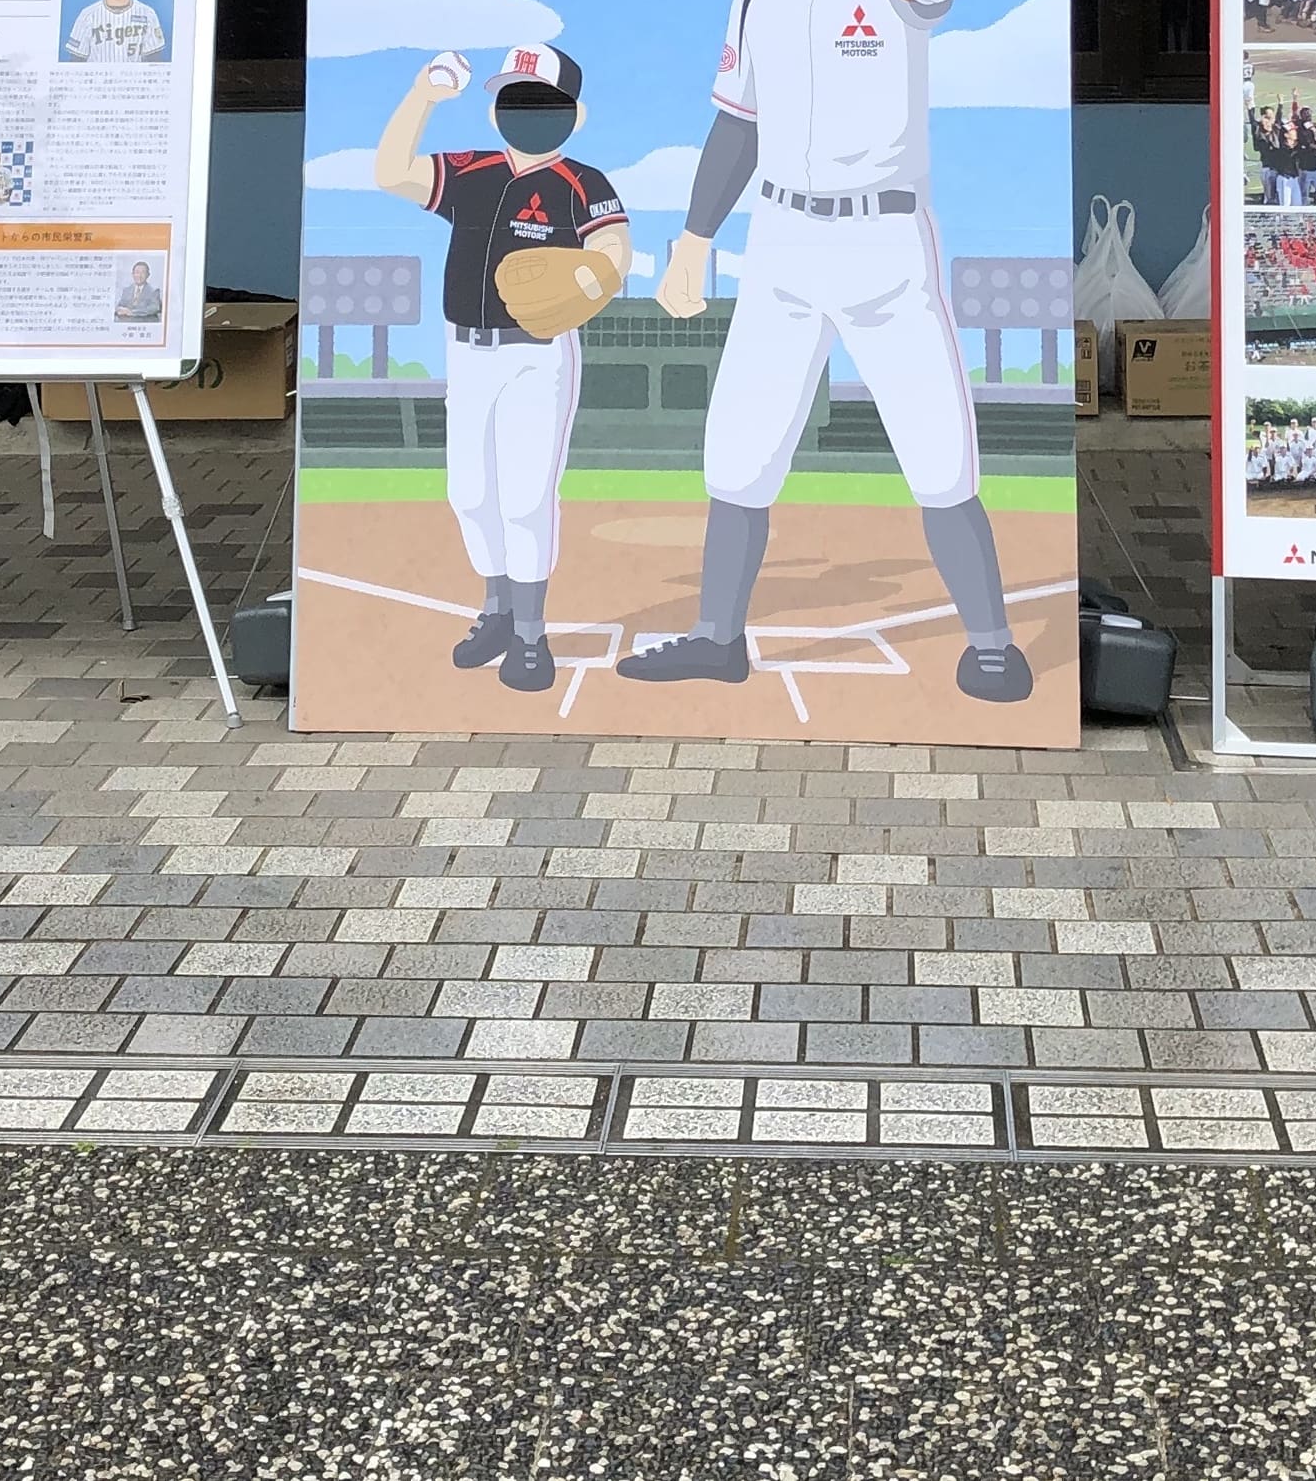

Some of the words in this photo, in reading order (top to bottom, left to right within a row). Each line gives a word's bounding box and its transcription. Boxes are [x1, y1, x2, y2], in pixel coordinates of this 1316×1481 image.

[92, 23, 148, 46] Tigers
[834, 40, 884, 49] MITSUBISHI
[841, 48, 878, 57] MOTORS
[589, 198, 621, 218] OKAZAKI
[510, 220, 554, 234] MITSUBISHI
[514, 229, 547, 241] MOTORS
